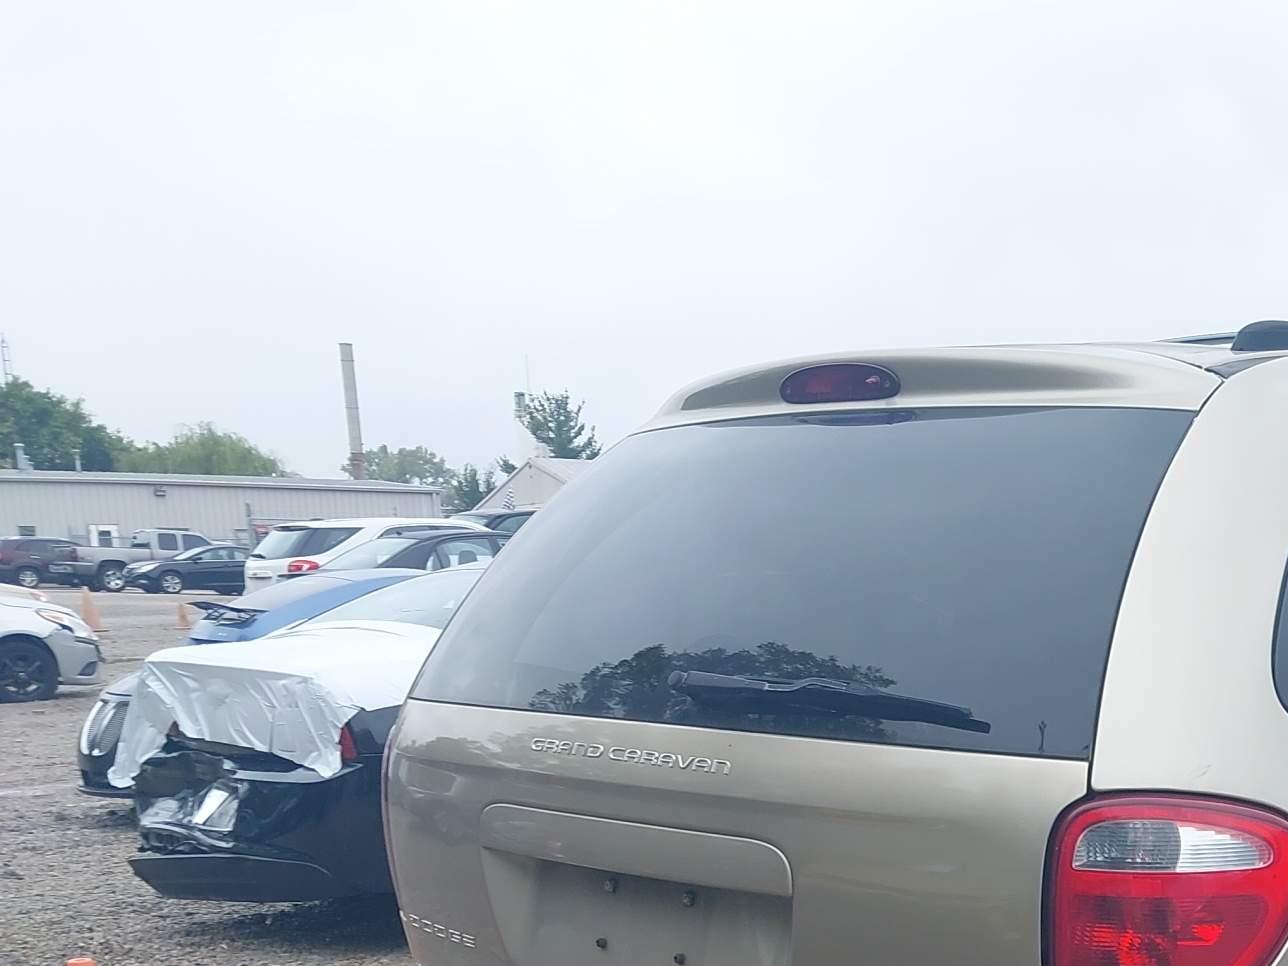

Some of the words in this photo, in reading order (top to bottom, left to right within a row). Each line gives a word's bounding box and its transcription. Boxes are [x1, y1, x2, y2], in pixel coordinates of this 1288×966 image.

[530, 737, 604, 760] GRAND
[606, 745, 732, 775] CARAVAN
[407, 913, 476, 948] DODGE
